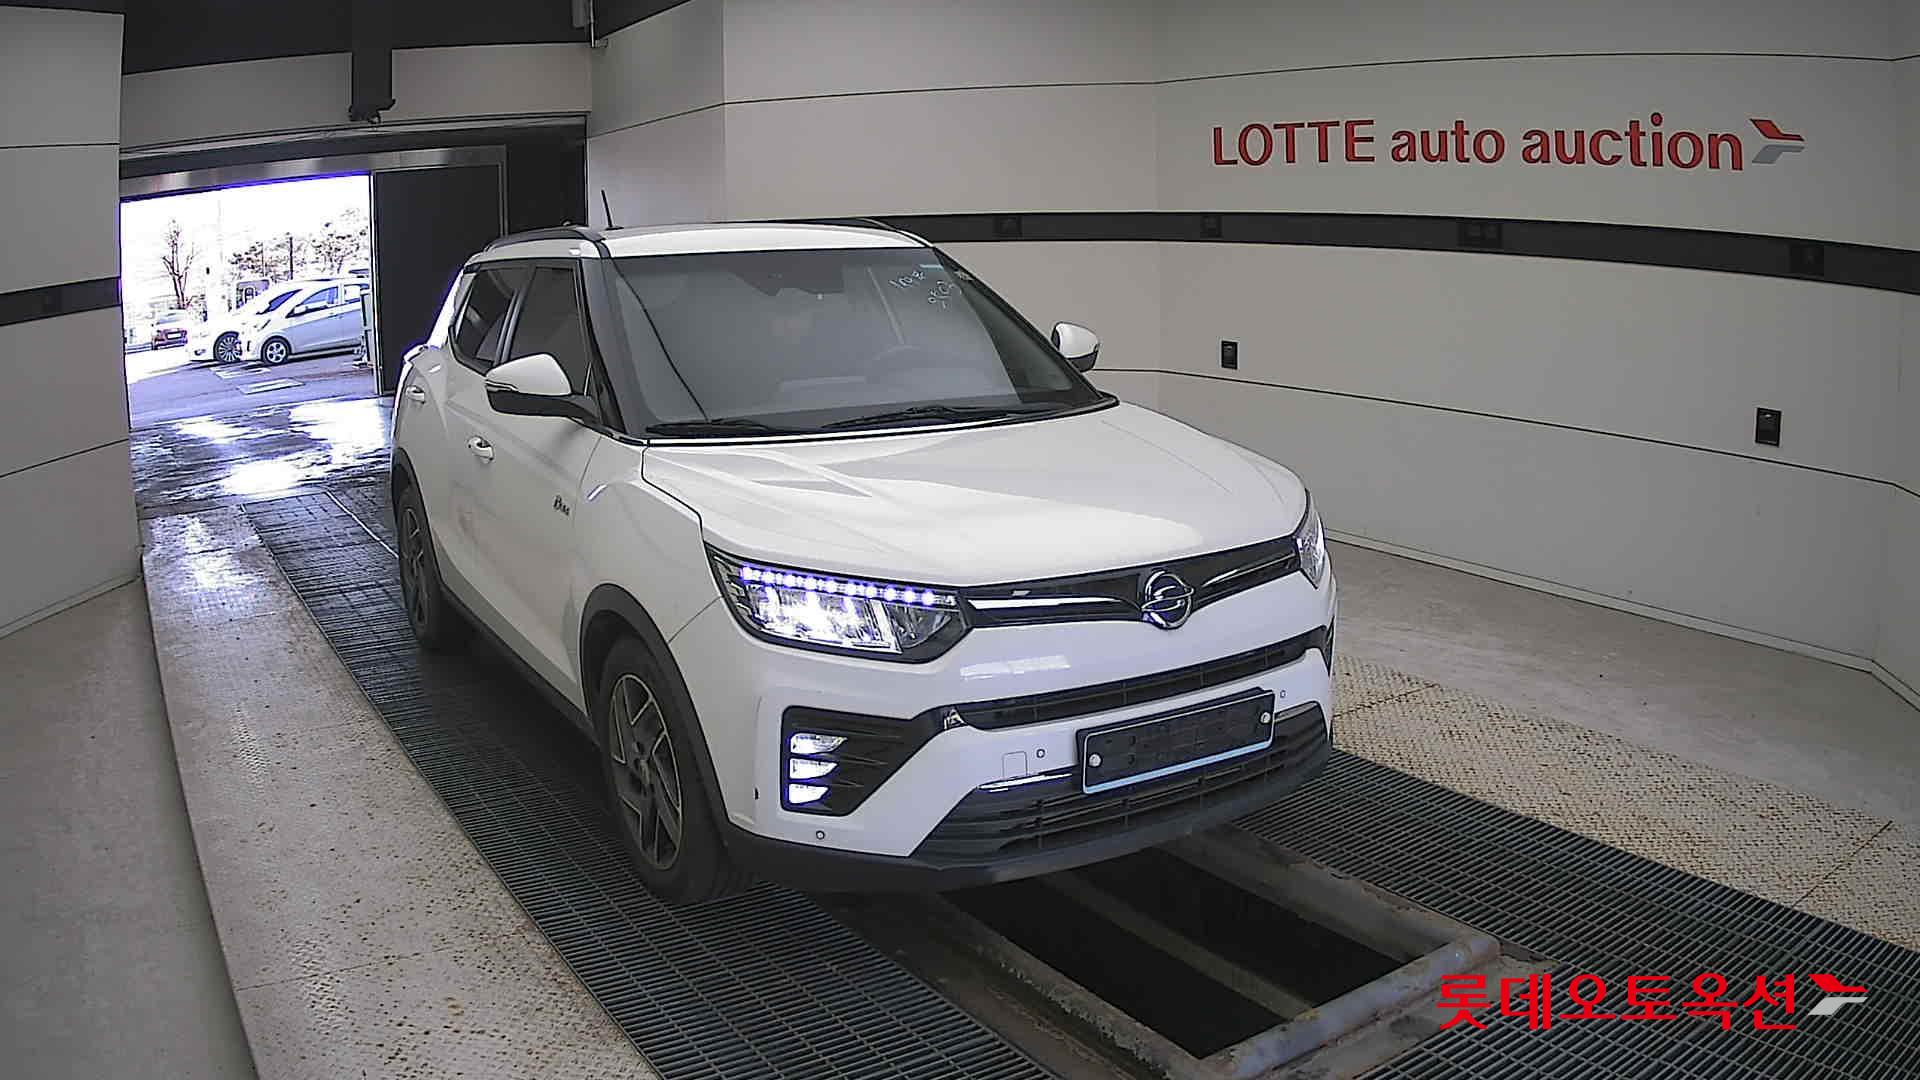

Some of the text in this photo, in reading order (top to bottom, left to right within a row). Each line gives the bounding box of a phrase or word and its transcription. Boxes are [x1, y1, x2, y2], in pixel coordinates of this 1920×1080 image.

[1212, 113, 1744, 171] LOTTE auto auction
